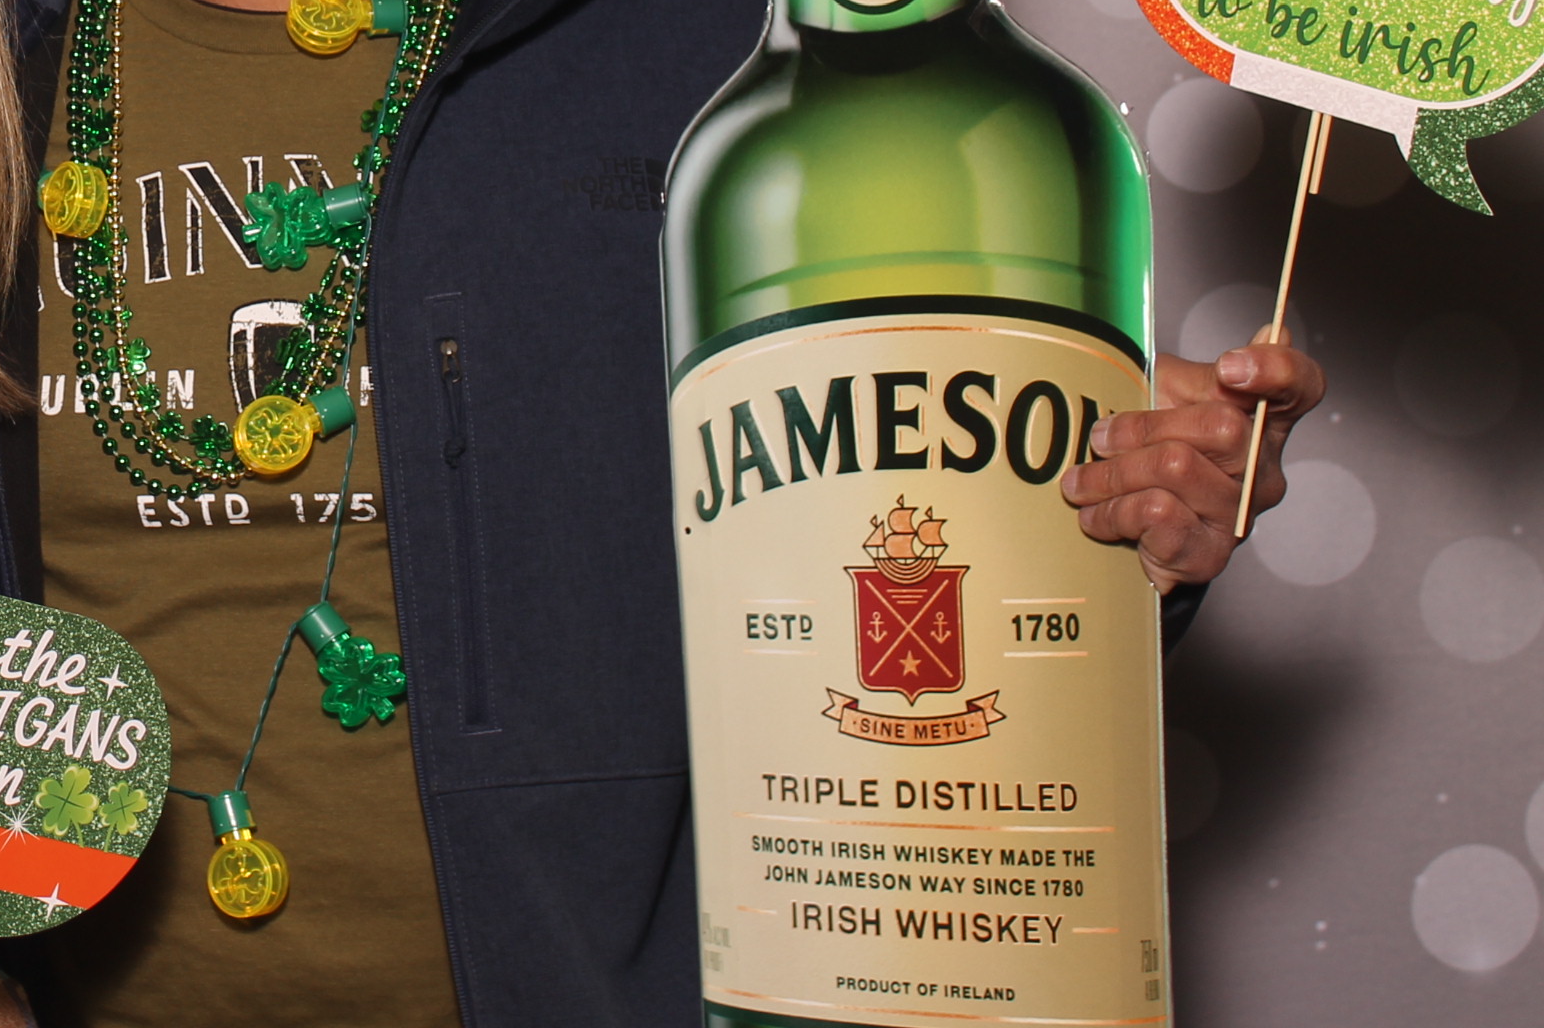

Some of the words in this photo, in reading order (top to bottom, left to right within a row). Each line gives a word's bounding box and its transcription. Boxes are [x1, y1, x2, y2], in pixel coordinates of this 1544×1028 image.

[1339, 7, 1491, 96] irish
[136, 493, 251, 528] ESTD
[745, 613, 814, 640] ESTD
[1011, 612, 1081, 642] 1780
[859, 717, 905, 738] SINE
[914, 720, 967, 739] METU
[762, 774, 879, 808] TRIPLE
[895, 780, 1079, 813] DISTILLED
[752, 835, 824, 858] SMOOTH
[830, 841, 886, 862] IRISH
[893, 845, 993, 867] WHISKEY
[1000, 848, 1057, 868] MADE
[1062, 849, 1096, 868] THE
[764, 865, 809, 884] JOHN
[814, 868, 912, 891] JAMESON
[919, 876, 966, 894] WAY
[973, 878, 1036, 896] SINCE
[1042, 880, 1084, 897] 1780
[791, 901, 883, 936] IRISH
[894, 909, 1064, 944] WHISKEY
[836, 976, 912, 997] PRODUCT
[917, 982, 939, 997] OF
[943, 983, 1015, 1002] IRELAND
